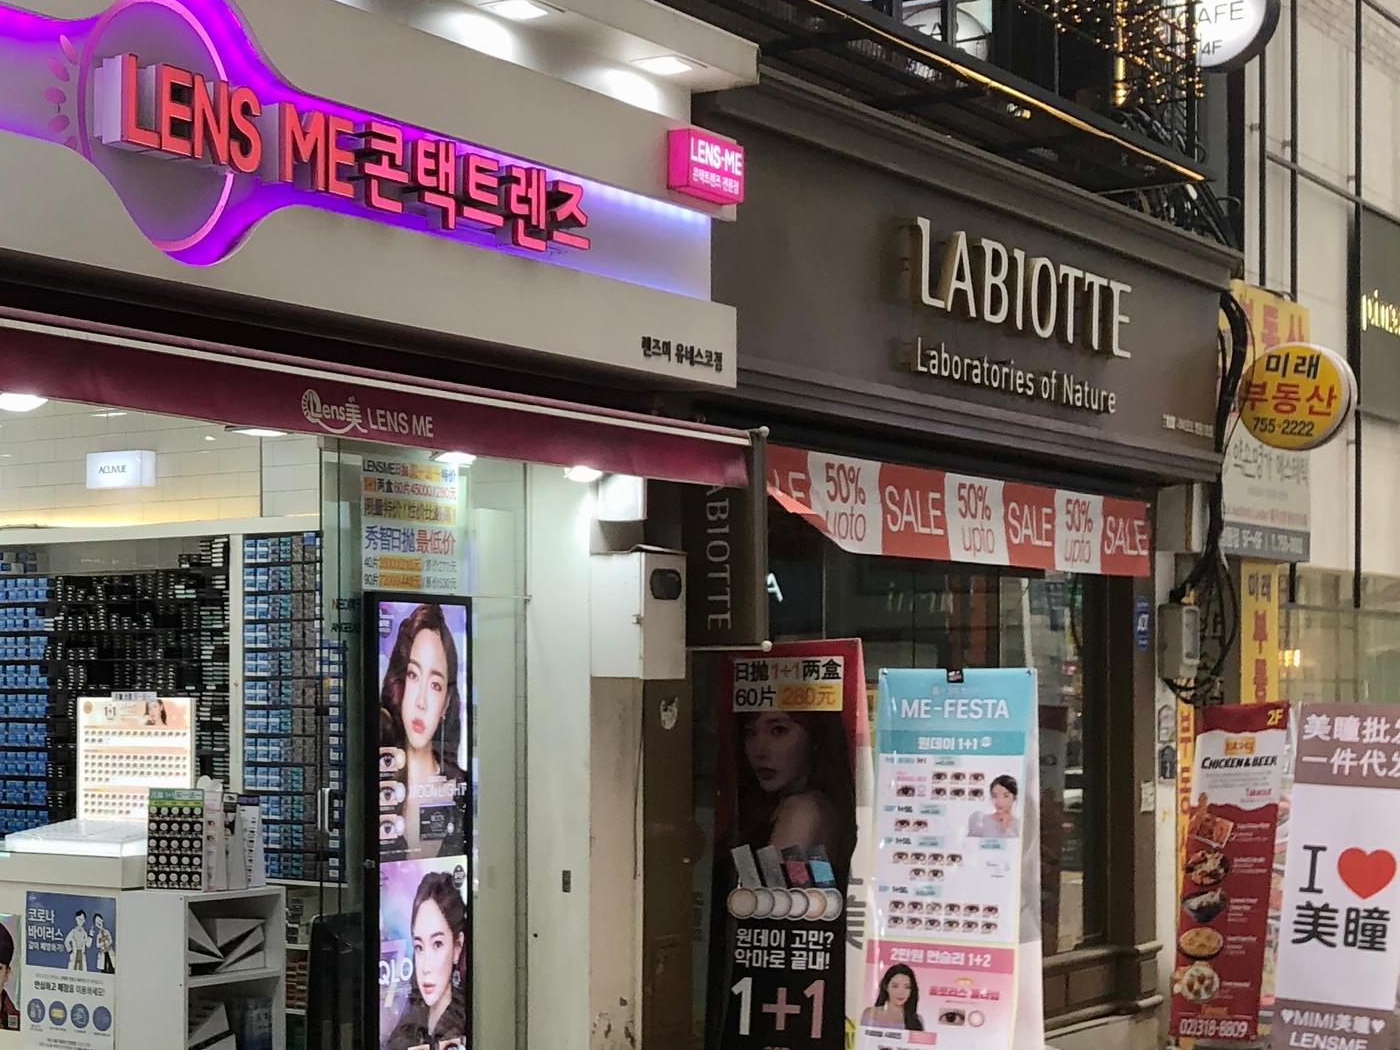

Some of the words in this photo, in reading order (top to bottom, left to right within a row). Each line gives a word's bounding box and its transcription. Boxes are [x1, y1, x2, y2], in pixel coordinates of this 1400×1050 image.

[1197, 0, 1245, 24] AFE
[116, 52, 262, 174] LENS
[362, 121, 592, 254] 콘택트렌즈
[915, 216, 1133, 360] LABIOTTE
[916, 337, 1035, 397] Laboratories
[1040, 372, 1058, 400] of
[1062, 374, 1118, 415] Nature
[1265, 351, 1321, 380] 미래
[1244, 381, 1338, 417] 부동산
[367, 406, 409, 435] LENS
[412, 413, 435, 438] ME
[824, 461, 867, 506] 50%
[956, 481, 993, 521] 50%
[884, 484, 946, 537] SALE
[1007, 500, 1054, 548] SALE
[1064, 497, 1094, 534] 50%
[1104, 513, 1150, 557] SALE
[900, 698, 1010, 720] ME-FESTA
[1266, 708, 1285, 726] 2F
[958, 736, 978, 751] 1+1
[1300, 845, 1327, 895] I
[27, 907, 56, 925] 코로나
[27, 924, 65, 942] 바이러스
[1290, 900, 1391, 953] 美瞳
[735, 928, 786, 949] 원데이
[790, 929, 835, 950] 고민?
[734, 949, 786, 969] 악마로
[790, 950, 831, 971] 끝내!
[966, 952, 992, 968] 1+2
[730, 976, 826, 1039] 1+1
